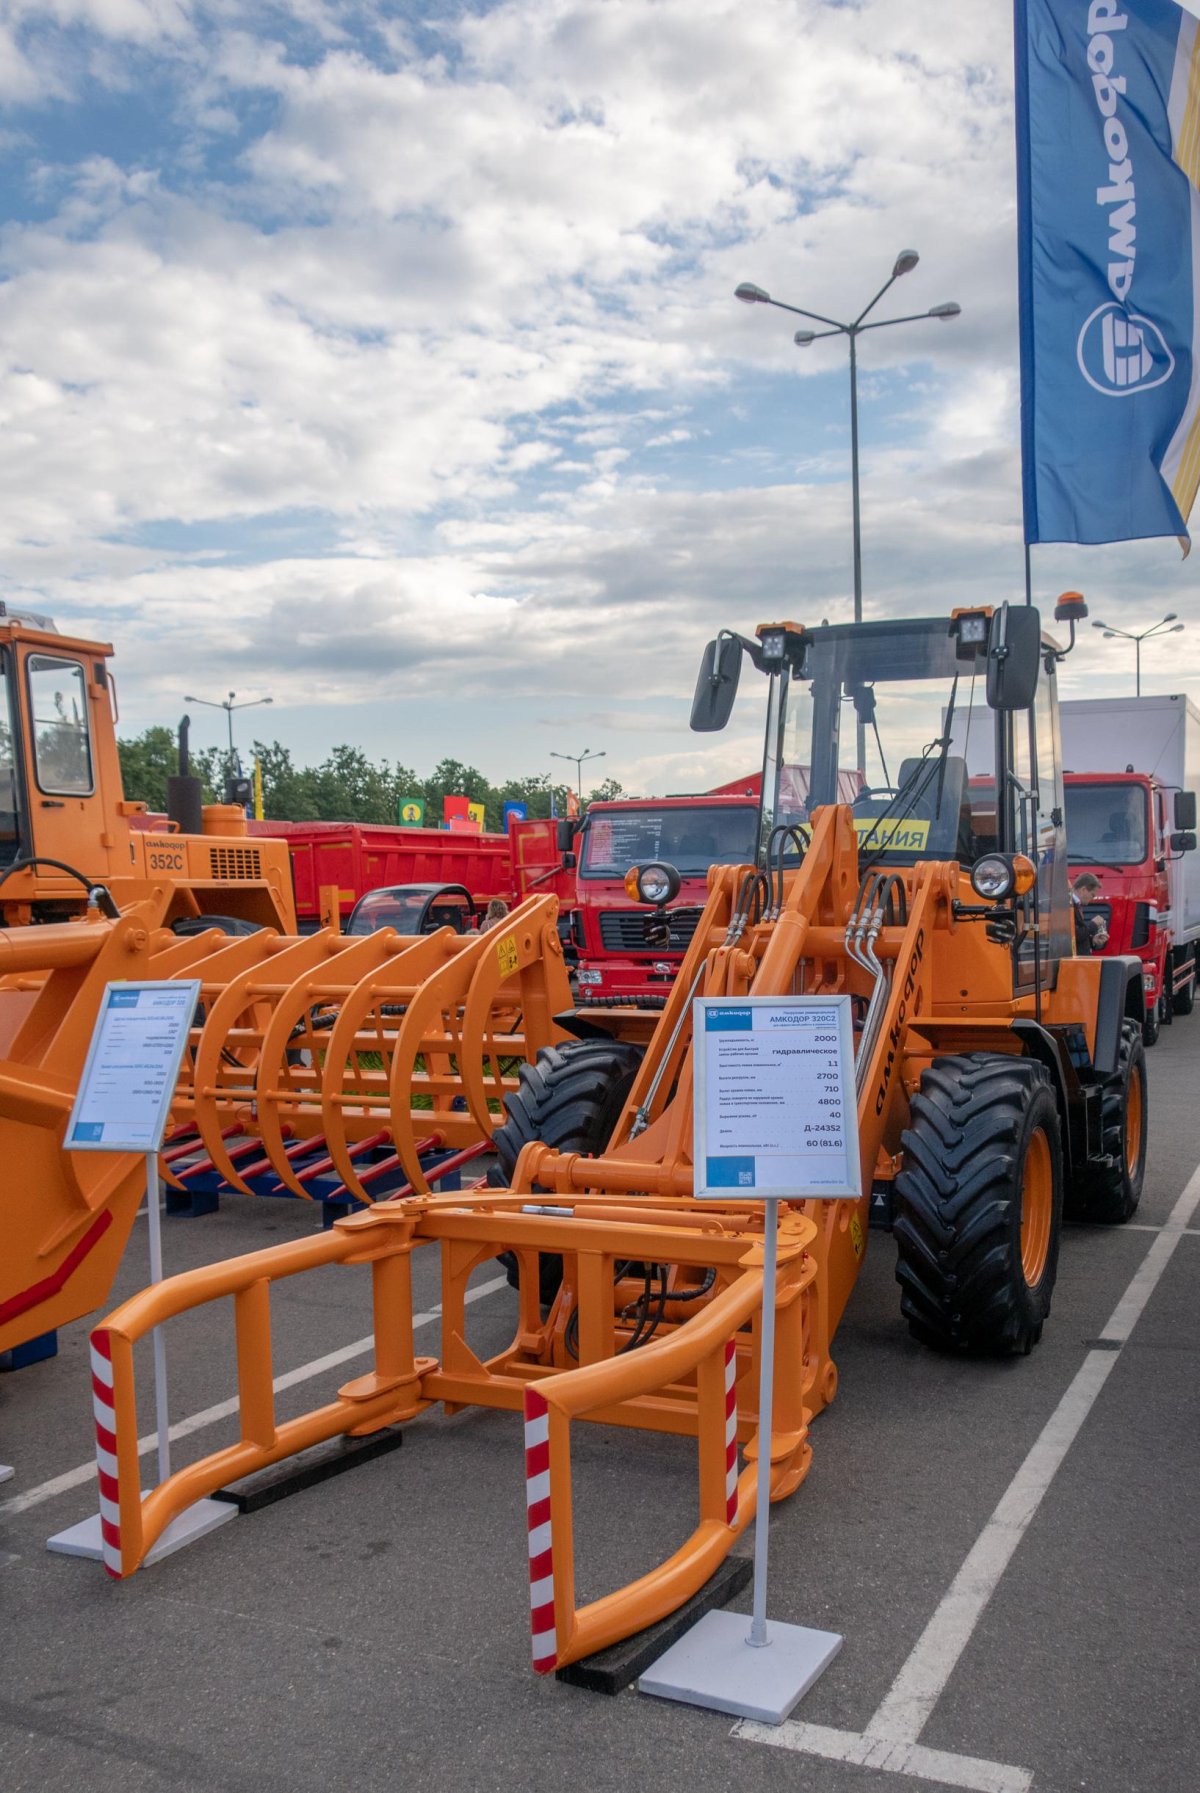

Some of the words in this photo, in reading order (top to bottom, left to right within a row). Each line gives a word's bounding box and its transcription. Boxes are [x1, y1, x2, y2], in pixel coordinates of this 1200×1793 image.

[145, 840, 186, 851] амкодор
[769, 1015, 810, 1023] АМКОДОР
[875, 927, 925, 1116] амкодор
[816, 1072, 839, 1080] 2700
[806, 1139, 818, 1147] 60
[820, 1139, 843, 1148] (81.6)
